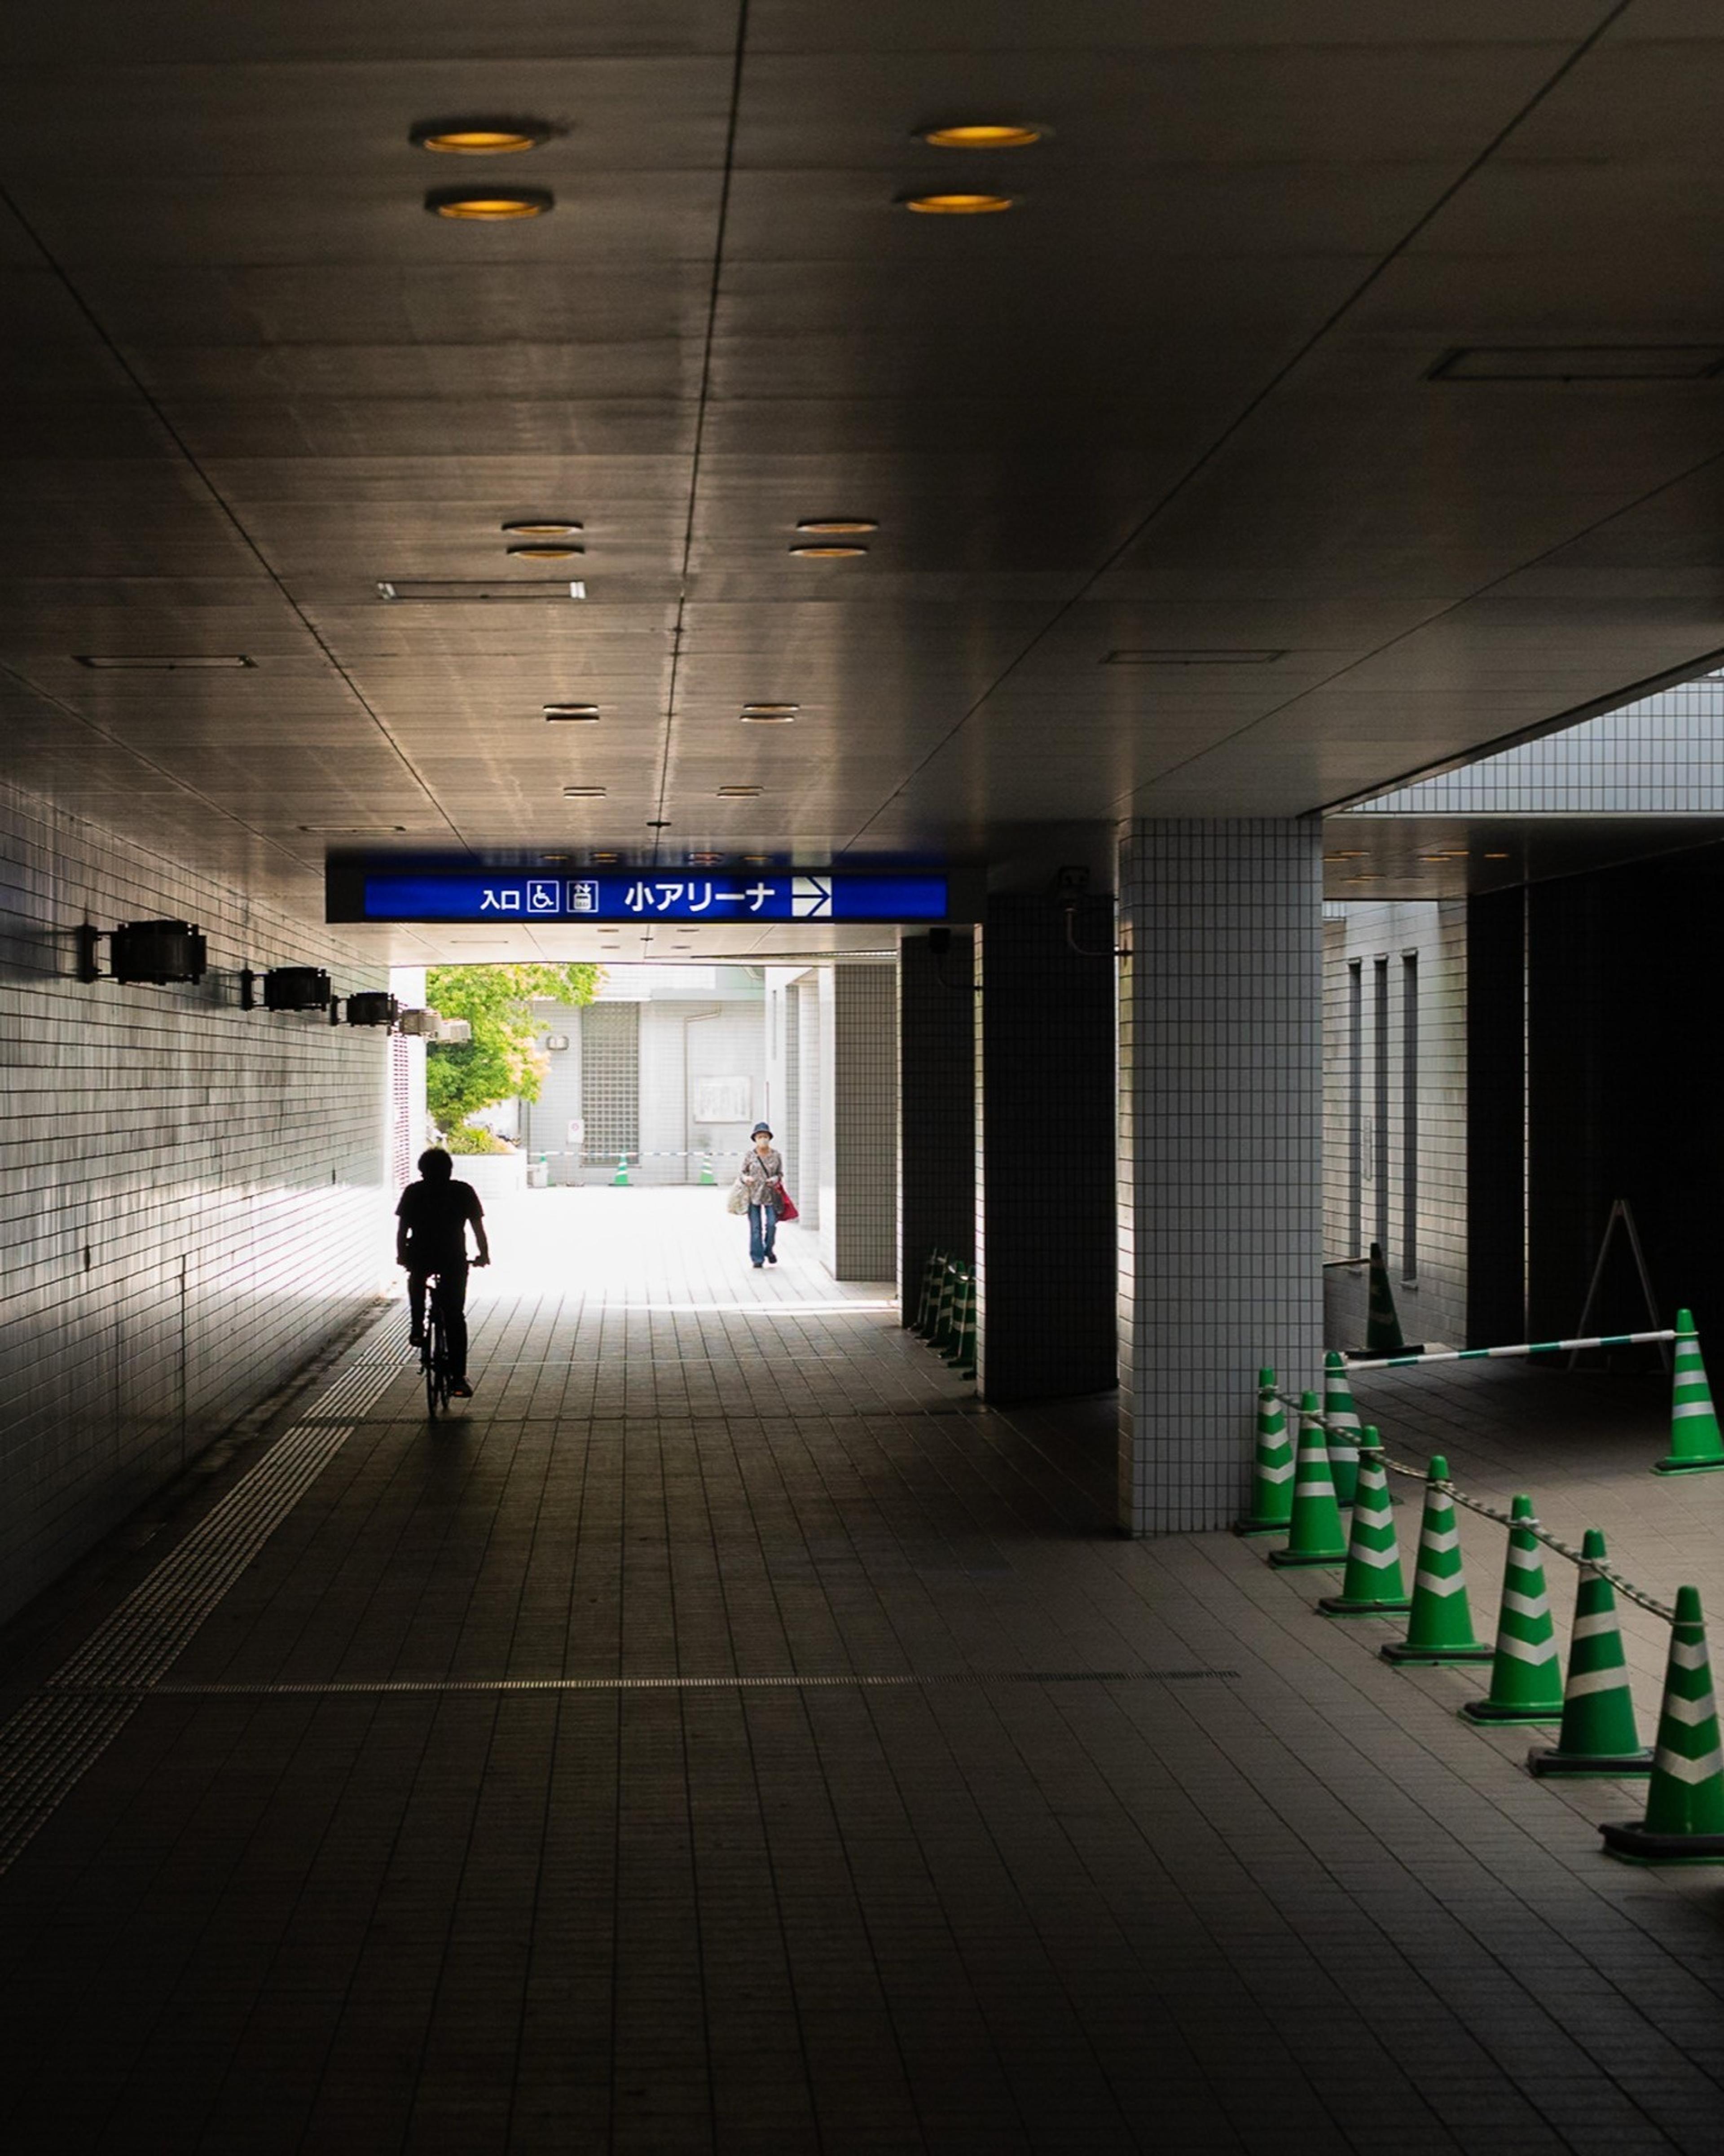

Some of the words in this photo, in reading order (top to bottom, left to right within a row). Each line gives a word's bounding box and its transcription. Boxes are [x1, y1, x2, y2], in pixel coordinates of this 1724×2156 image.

[479, 890, 520, 910] 入口
[624, 881, 775, 912] 小アリーナ
